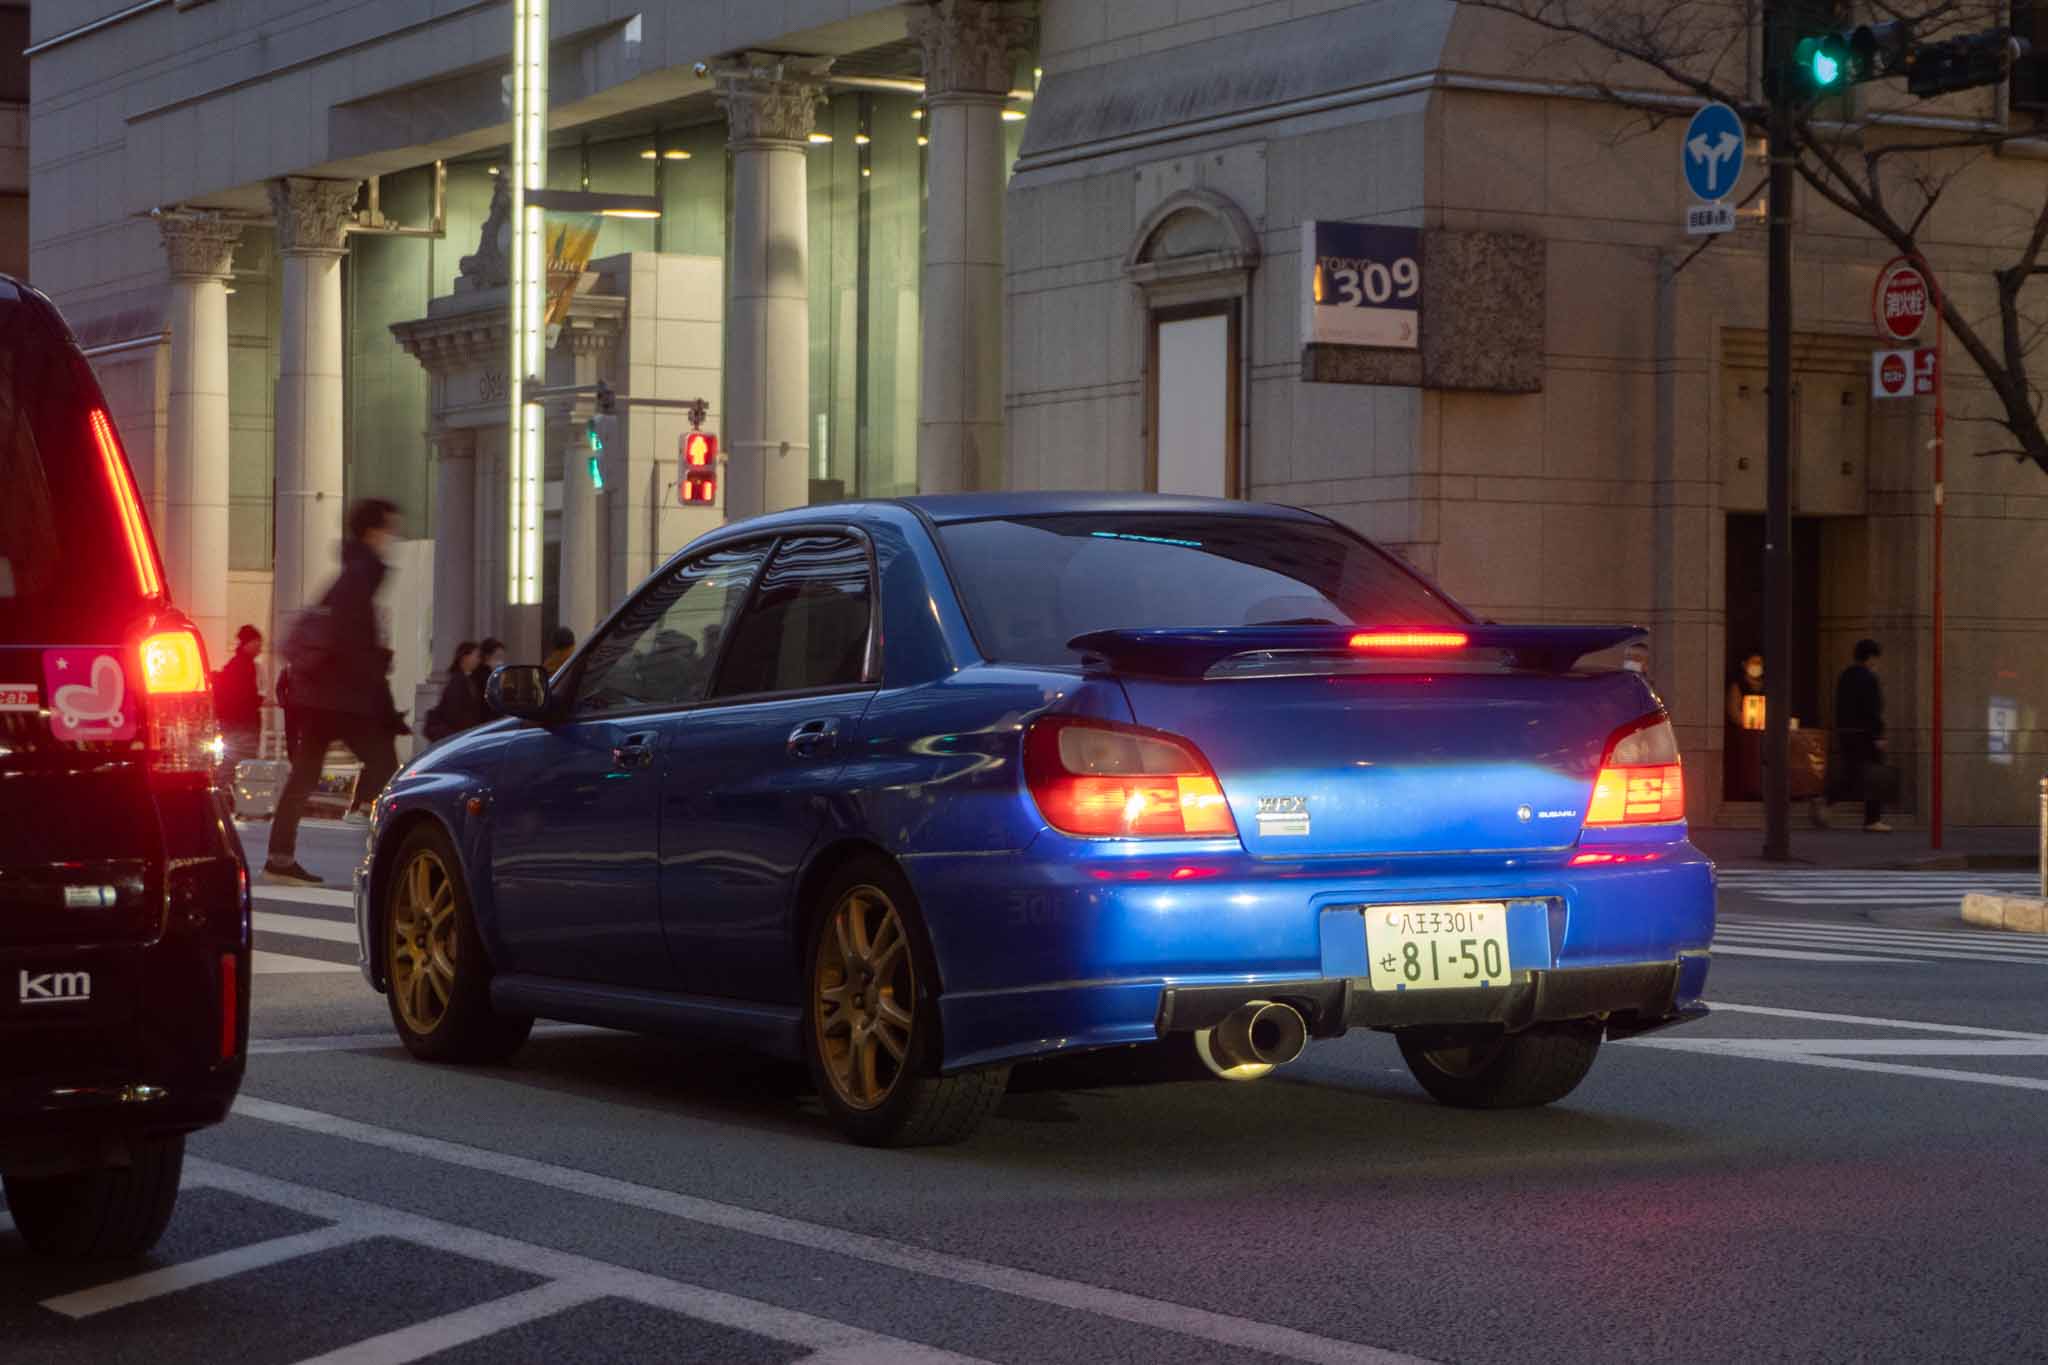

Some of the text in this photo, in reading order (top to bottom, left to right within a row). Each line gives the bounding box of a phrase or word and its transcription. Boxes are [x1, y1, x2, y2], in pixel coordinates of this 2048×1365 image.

[1332, 256, 1420, 307] 309
[1380, 938, 1502, 981] せ 81-50
[20, 969, 91, 998] km
